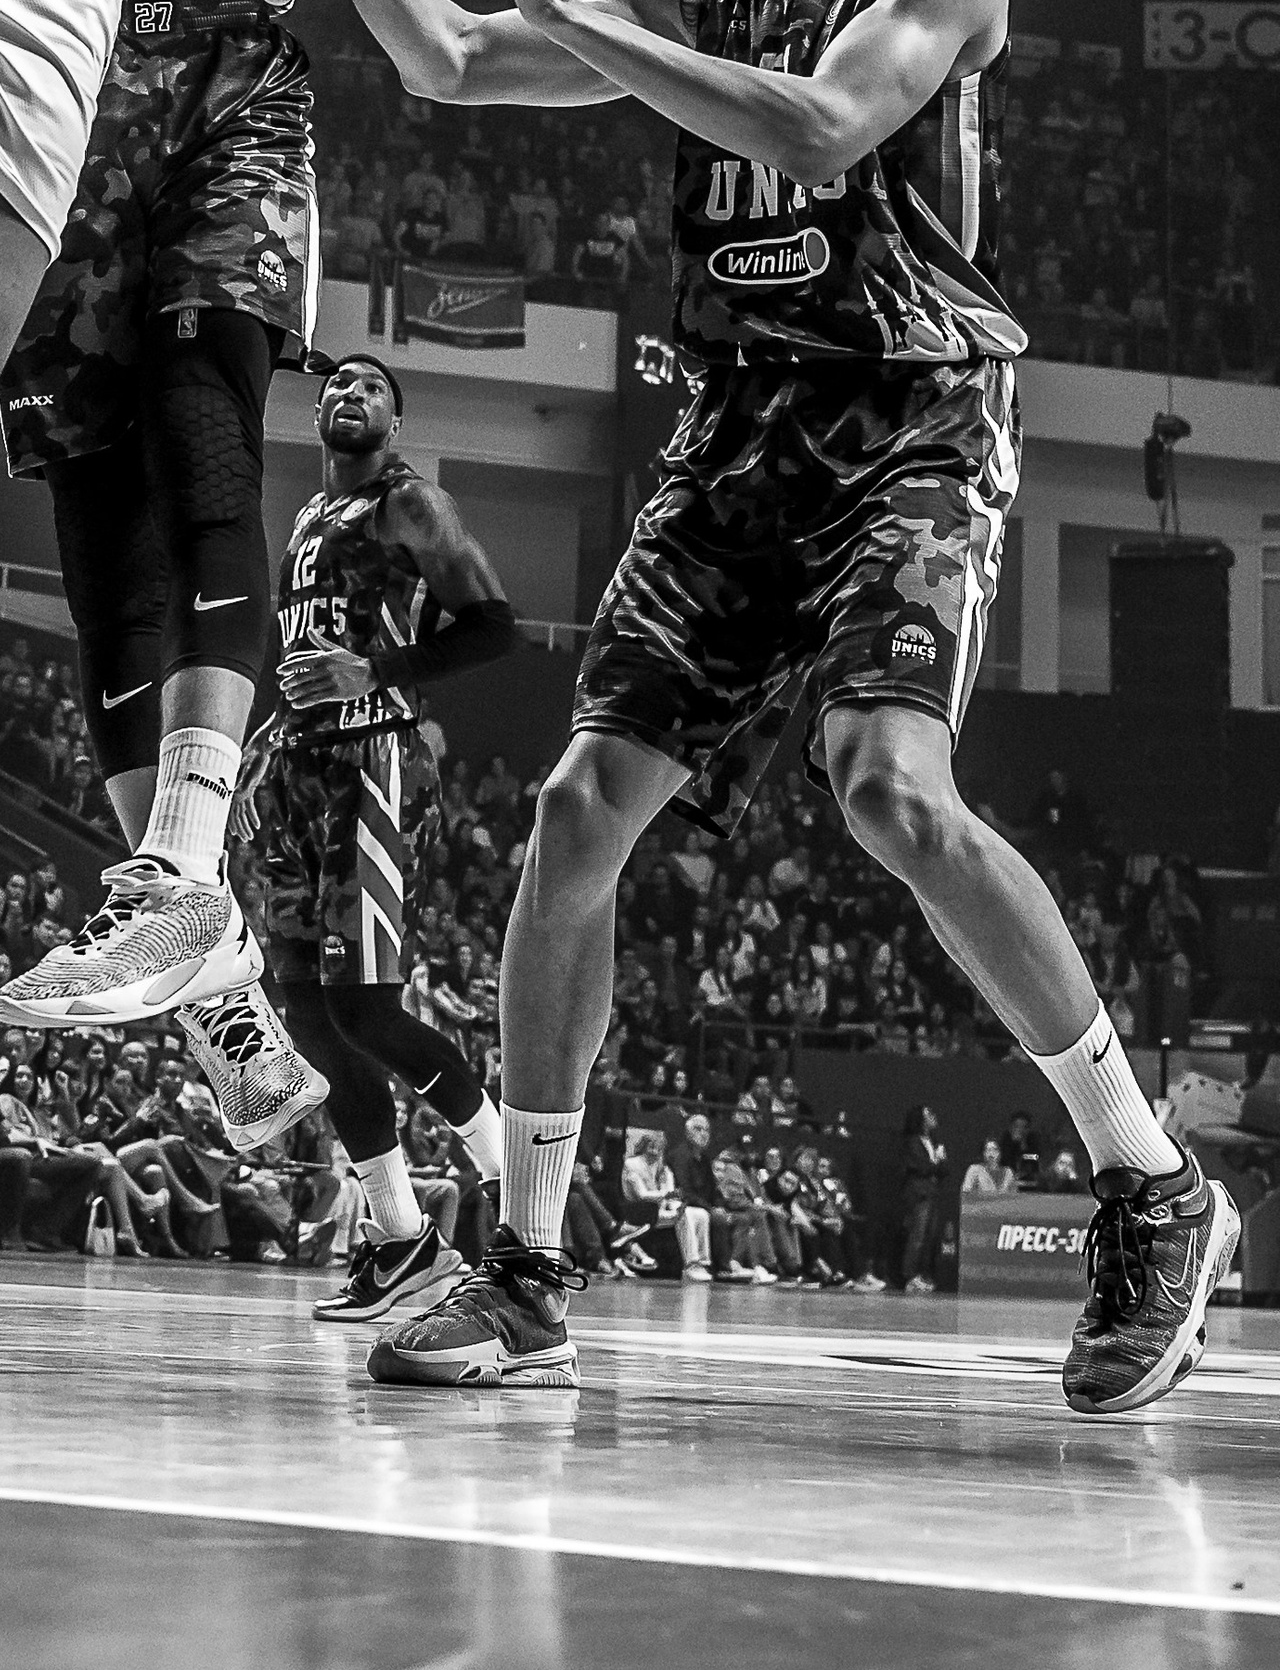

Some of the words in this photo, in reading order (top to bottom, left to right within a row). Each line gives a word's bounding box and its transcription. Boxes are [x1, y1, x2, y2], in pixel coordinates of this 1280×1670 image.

[134, 1, 173, 33] 27
[727, 247, 806, 275] Winlin
[9, 394, 54, 411] MAXX
[291, 536, 323, 591] 12
[891, 639, 937, 660] UNICS
[997, 1224, 1089, 1254] ПРЕСС-ЗО
